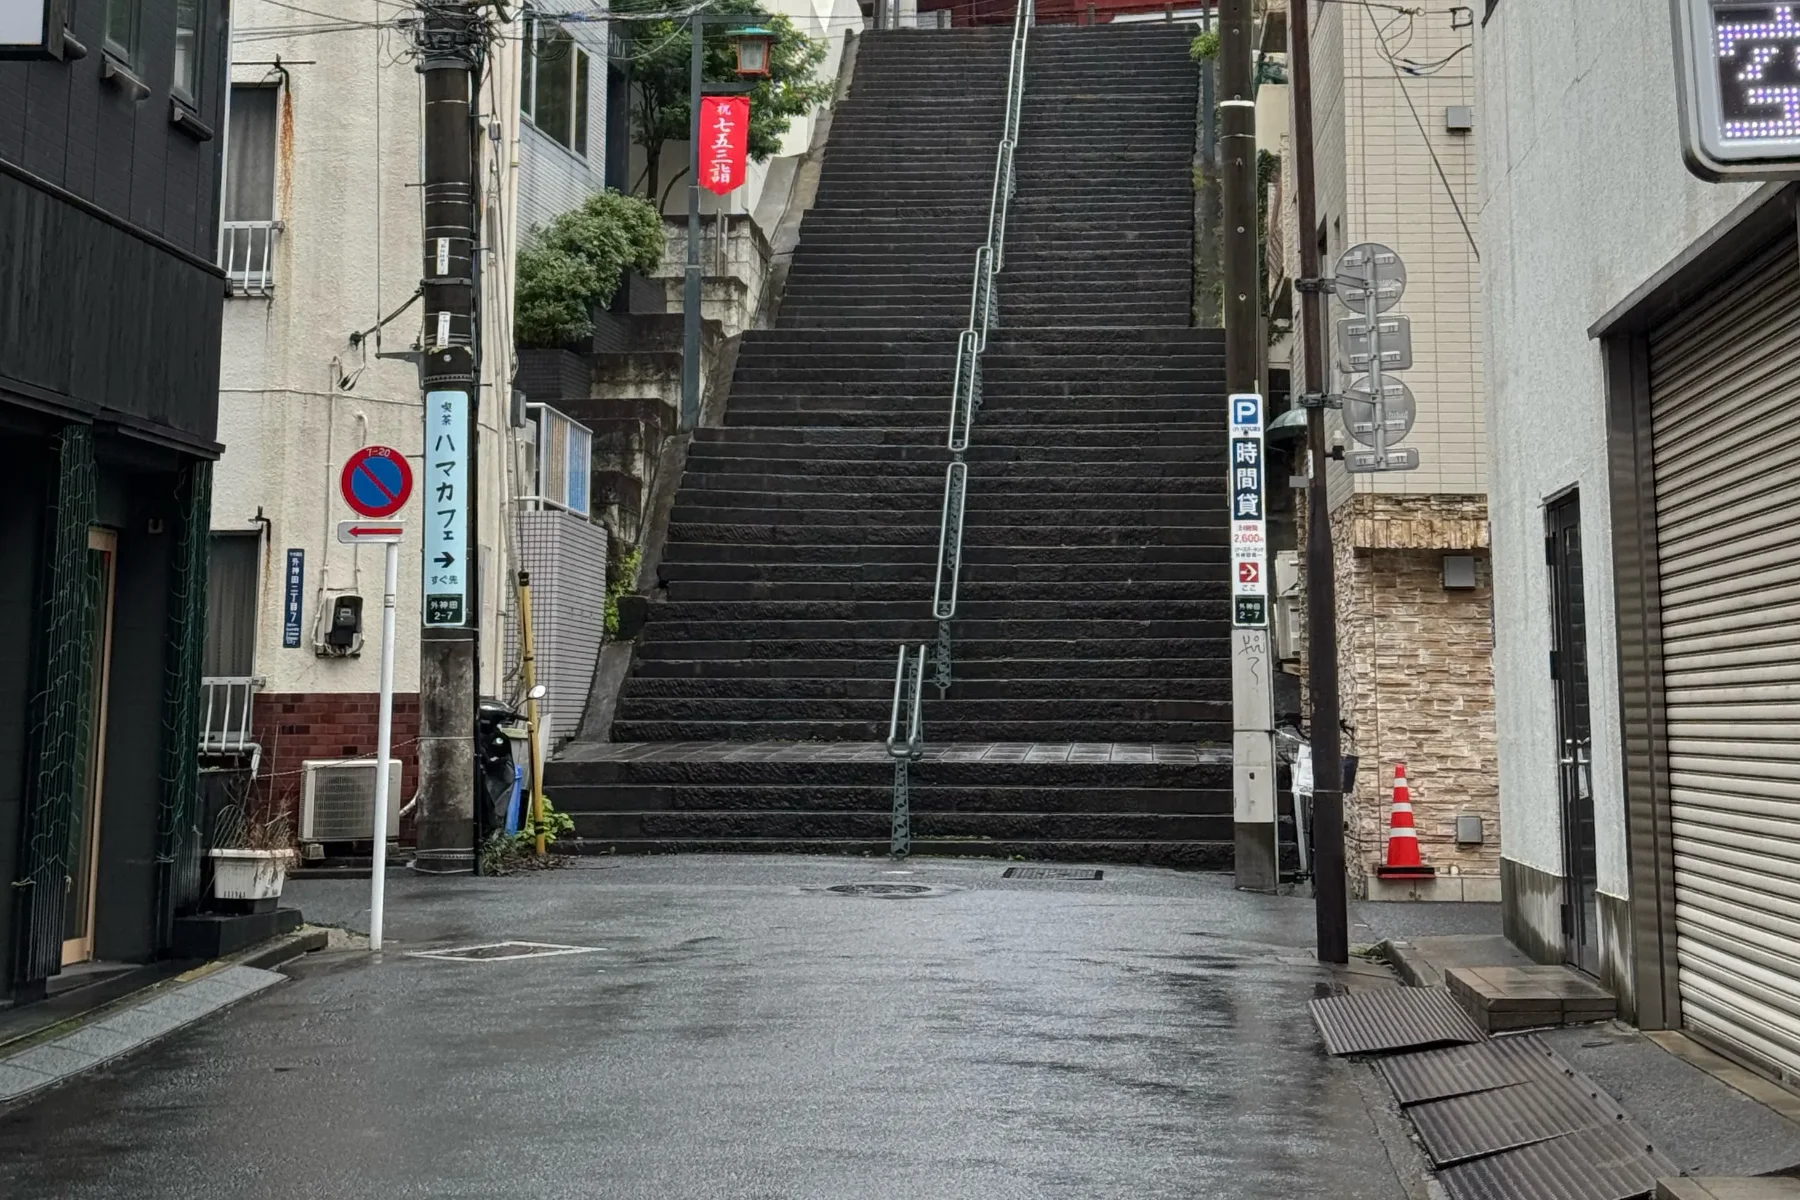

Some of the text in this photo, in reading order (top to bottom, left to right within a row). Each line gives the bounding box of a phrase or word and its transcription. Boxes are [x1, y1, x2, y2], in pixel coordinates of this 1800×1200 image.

[365, 447, 391, 457] 7-20
[1236, 441, 1259, 517] 時間貸
[430, 575, 458, 585] すぐ先
[1241, 584, 1257, 592] ここ
[430, 600, 458, 610] 外神田
[1238, 602, 1261, 610] 外神田
[434, 611, 453, 621] 2-7
[1239, 611, 1260, 620] 2-7
